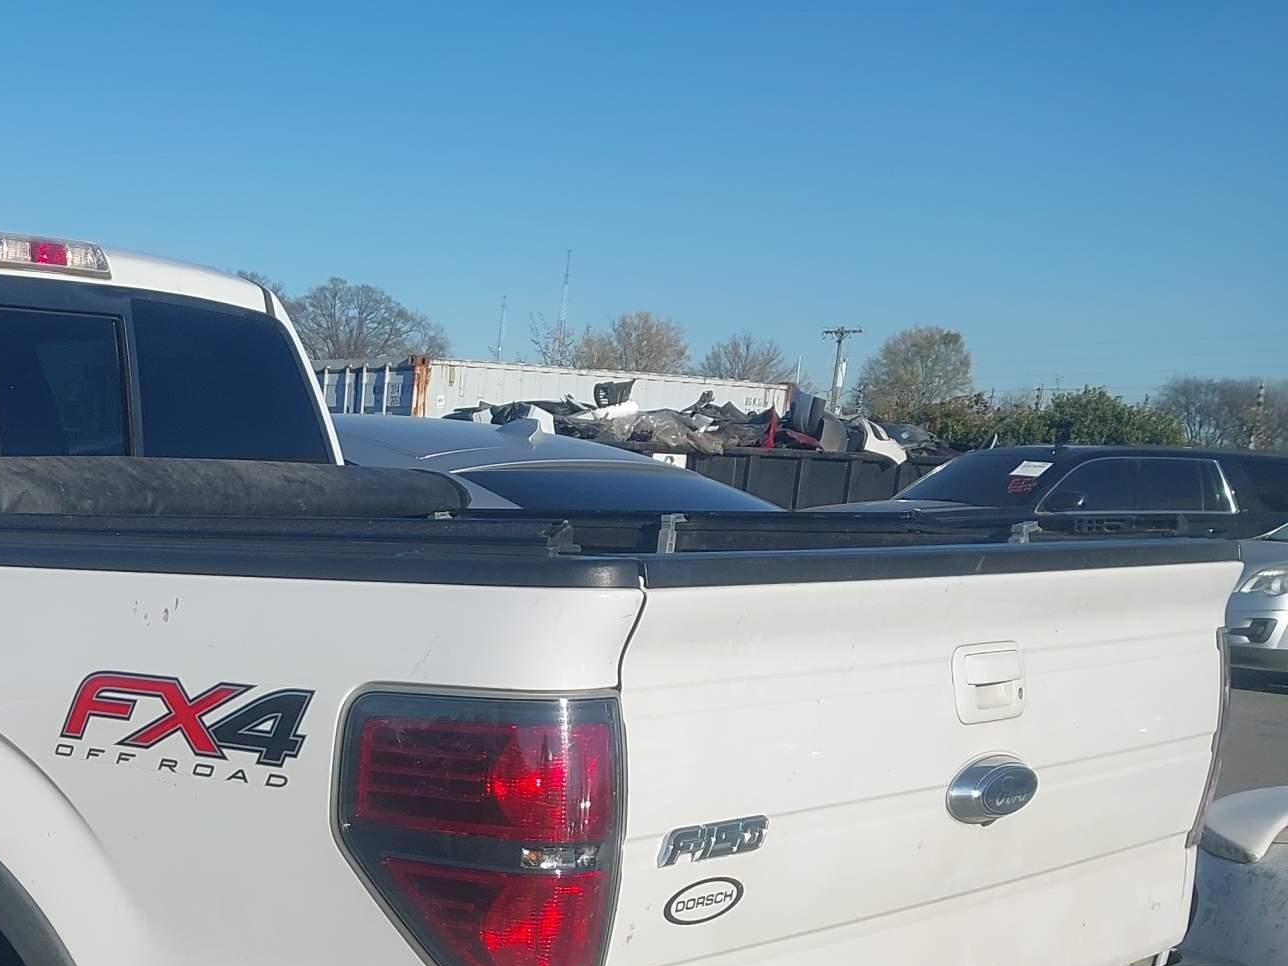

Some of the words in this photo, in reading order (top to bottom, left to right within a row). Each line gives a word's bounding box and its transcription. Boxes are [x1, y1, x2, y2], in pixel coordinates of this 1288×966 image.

[59, 670, 316, 768] FX4
[54, 742, 137, 765] OFF
[157, 757, 289, 788] ROAD
[673, 889, 735, 914] DORSCH
